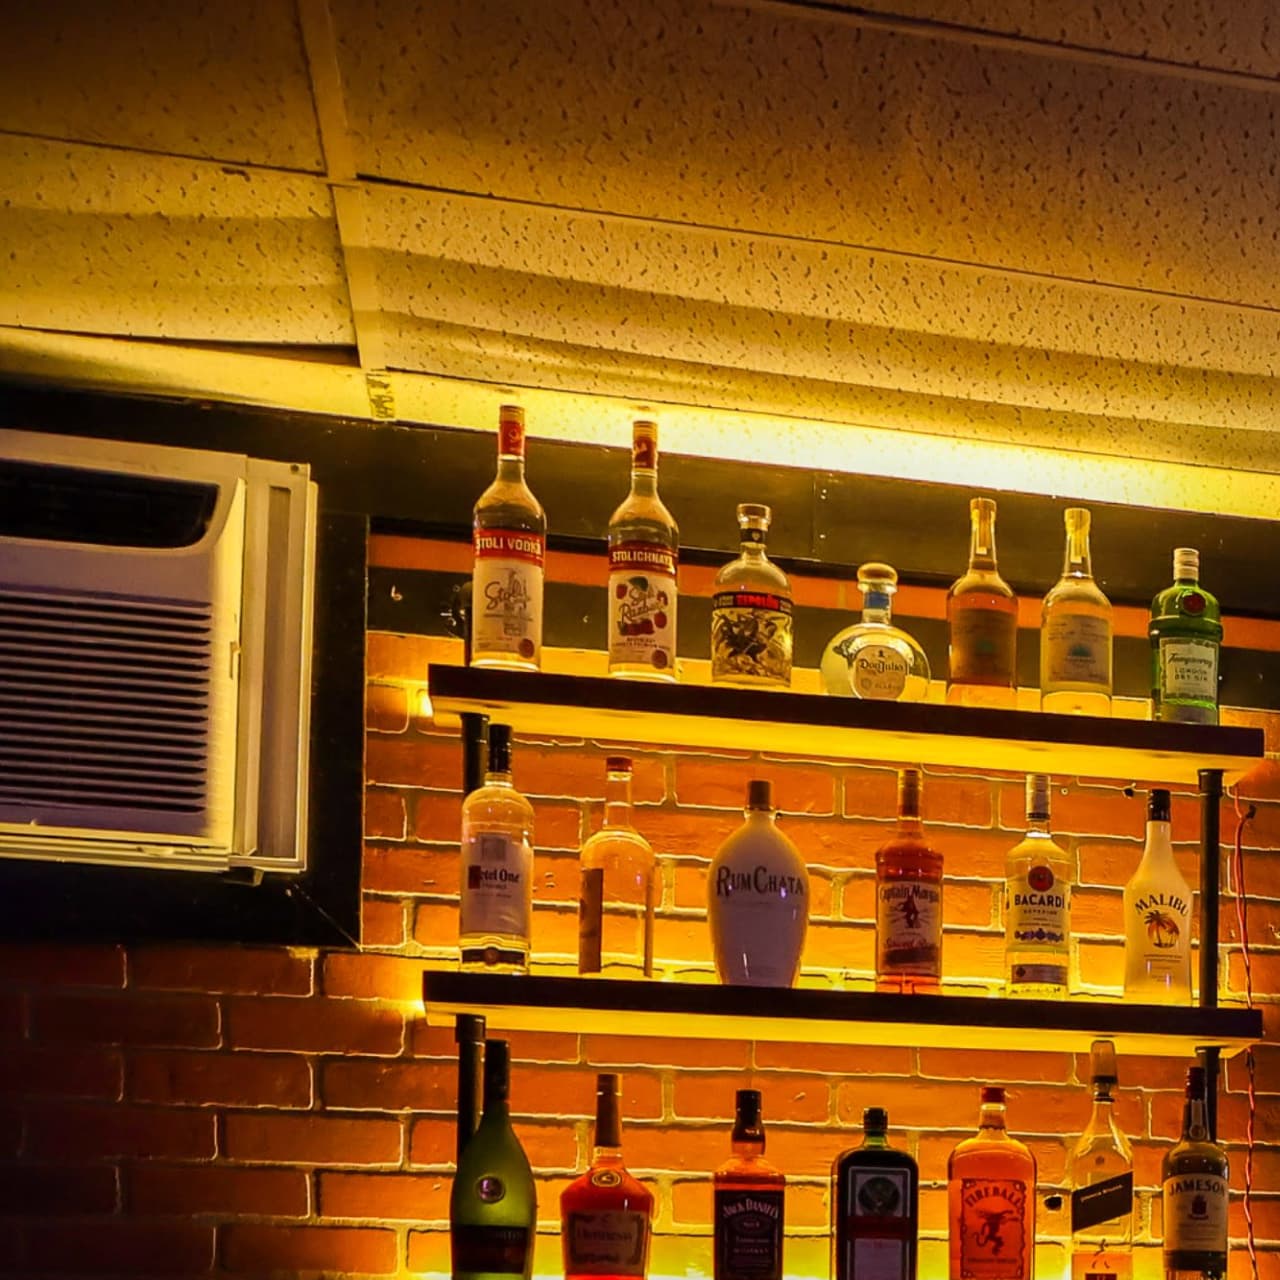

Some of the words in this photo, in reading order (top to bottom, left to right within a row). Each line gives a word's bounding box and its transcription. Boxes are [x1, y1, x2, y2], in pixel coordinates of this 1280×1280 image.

[1135, 893, 1189, 916] MALIBU
[965, 1186, 1023, 1209] FIREBALL
[1169, 1179, 1225, 1197] JAMESON
